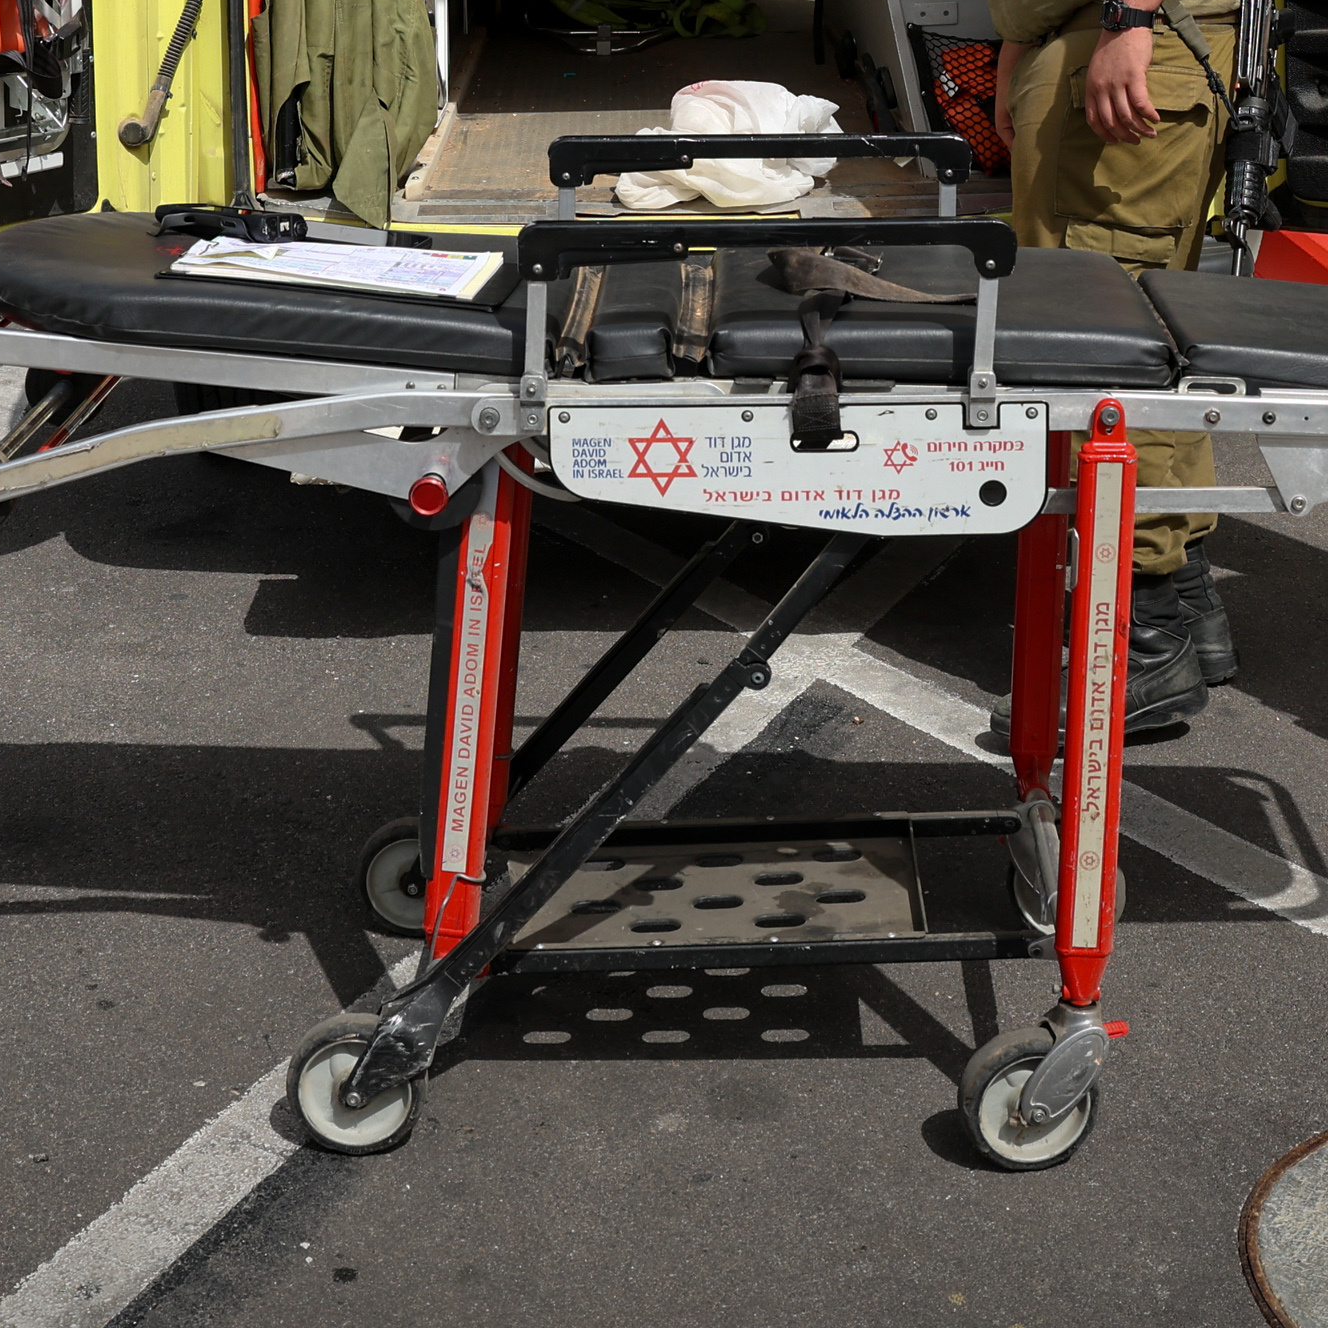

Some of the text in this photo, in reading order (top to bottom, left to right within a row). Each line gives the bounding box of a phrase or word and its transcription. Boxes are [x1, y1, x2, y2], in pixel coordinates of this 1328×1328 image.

[572, 437, 612, 448] MAGEN
[704, 436, 752, 451] מגן דוד
[926, 440, 1025, 454] במקרה חירום
[572, 448, 607, 458] DAVID
[719, 450, 752, 463] אדום
[572, 458, 607, 468] ADOM
[701, 463, 753, 478] בישראל
[948, 459, 1005, 472] חייג 101
[572, 468, 624, 479] IN ISRAEL
[703, 488, 901, 503] מגן דוד אדום בישראל
[818, 502, 870, 520] הלאומי
[875, 502, 923, 520] ההצלה
[468, 619, 482, 636] IN
[463, 643, 479, 699] ADOM
[1082, 602, 1112, 812] מגן דוד אדום בישראל
[457, 704, 474, 760] DAVID
[451, 766, 469, 833] MAGEN
